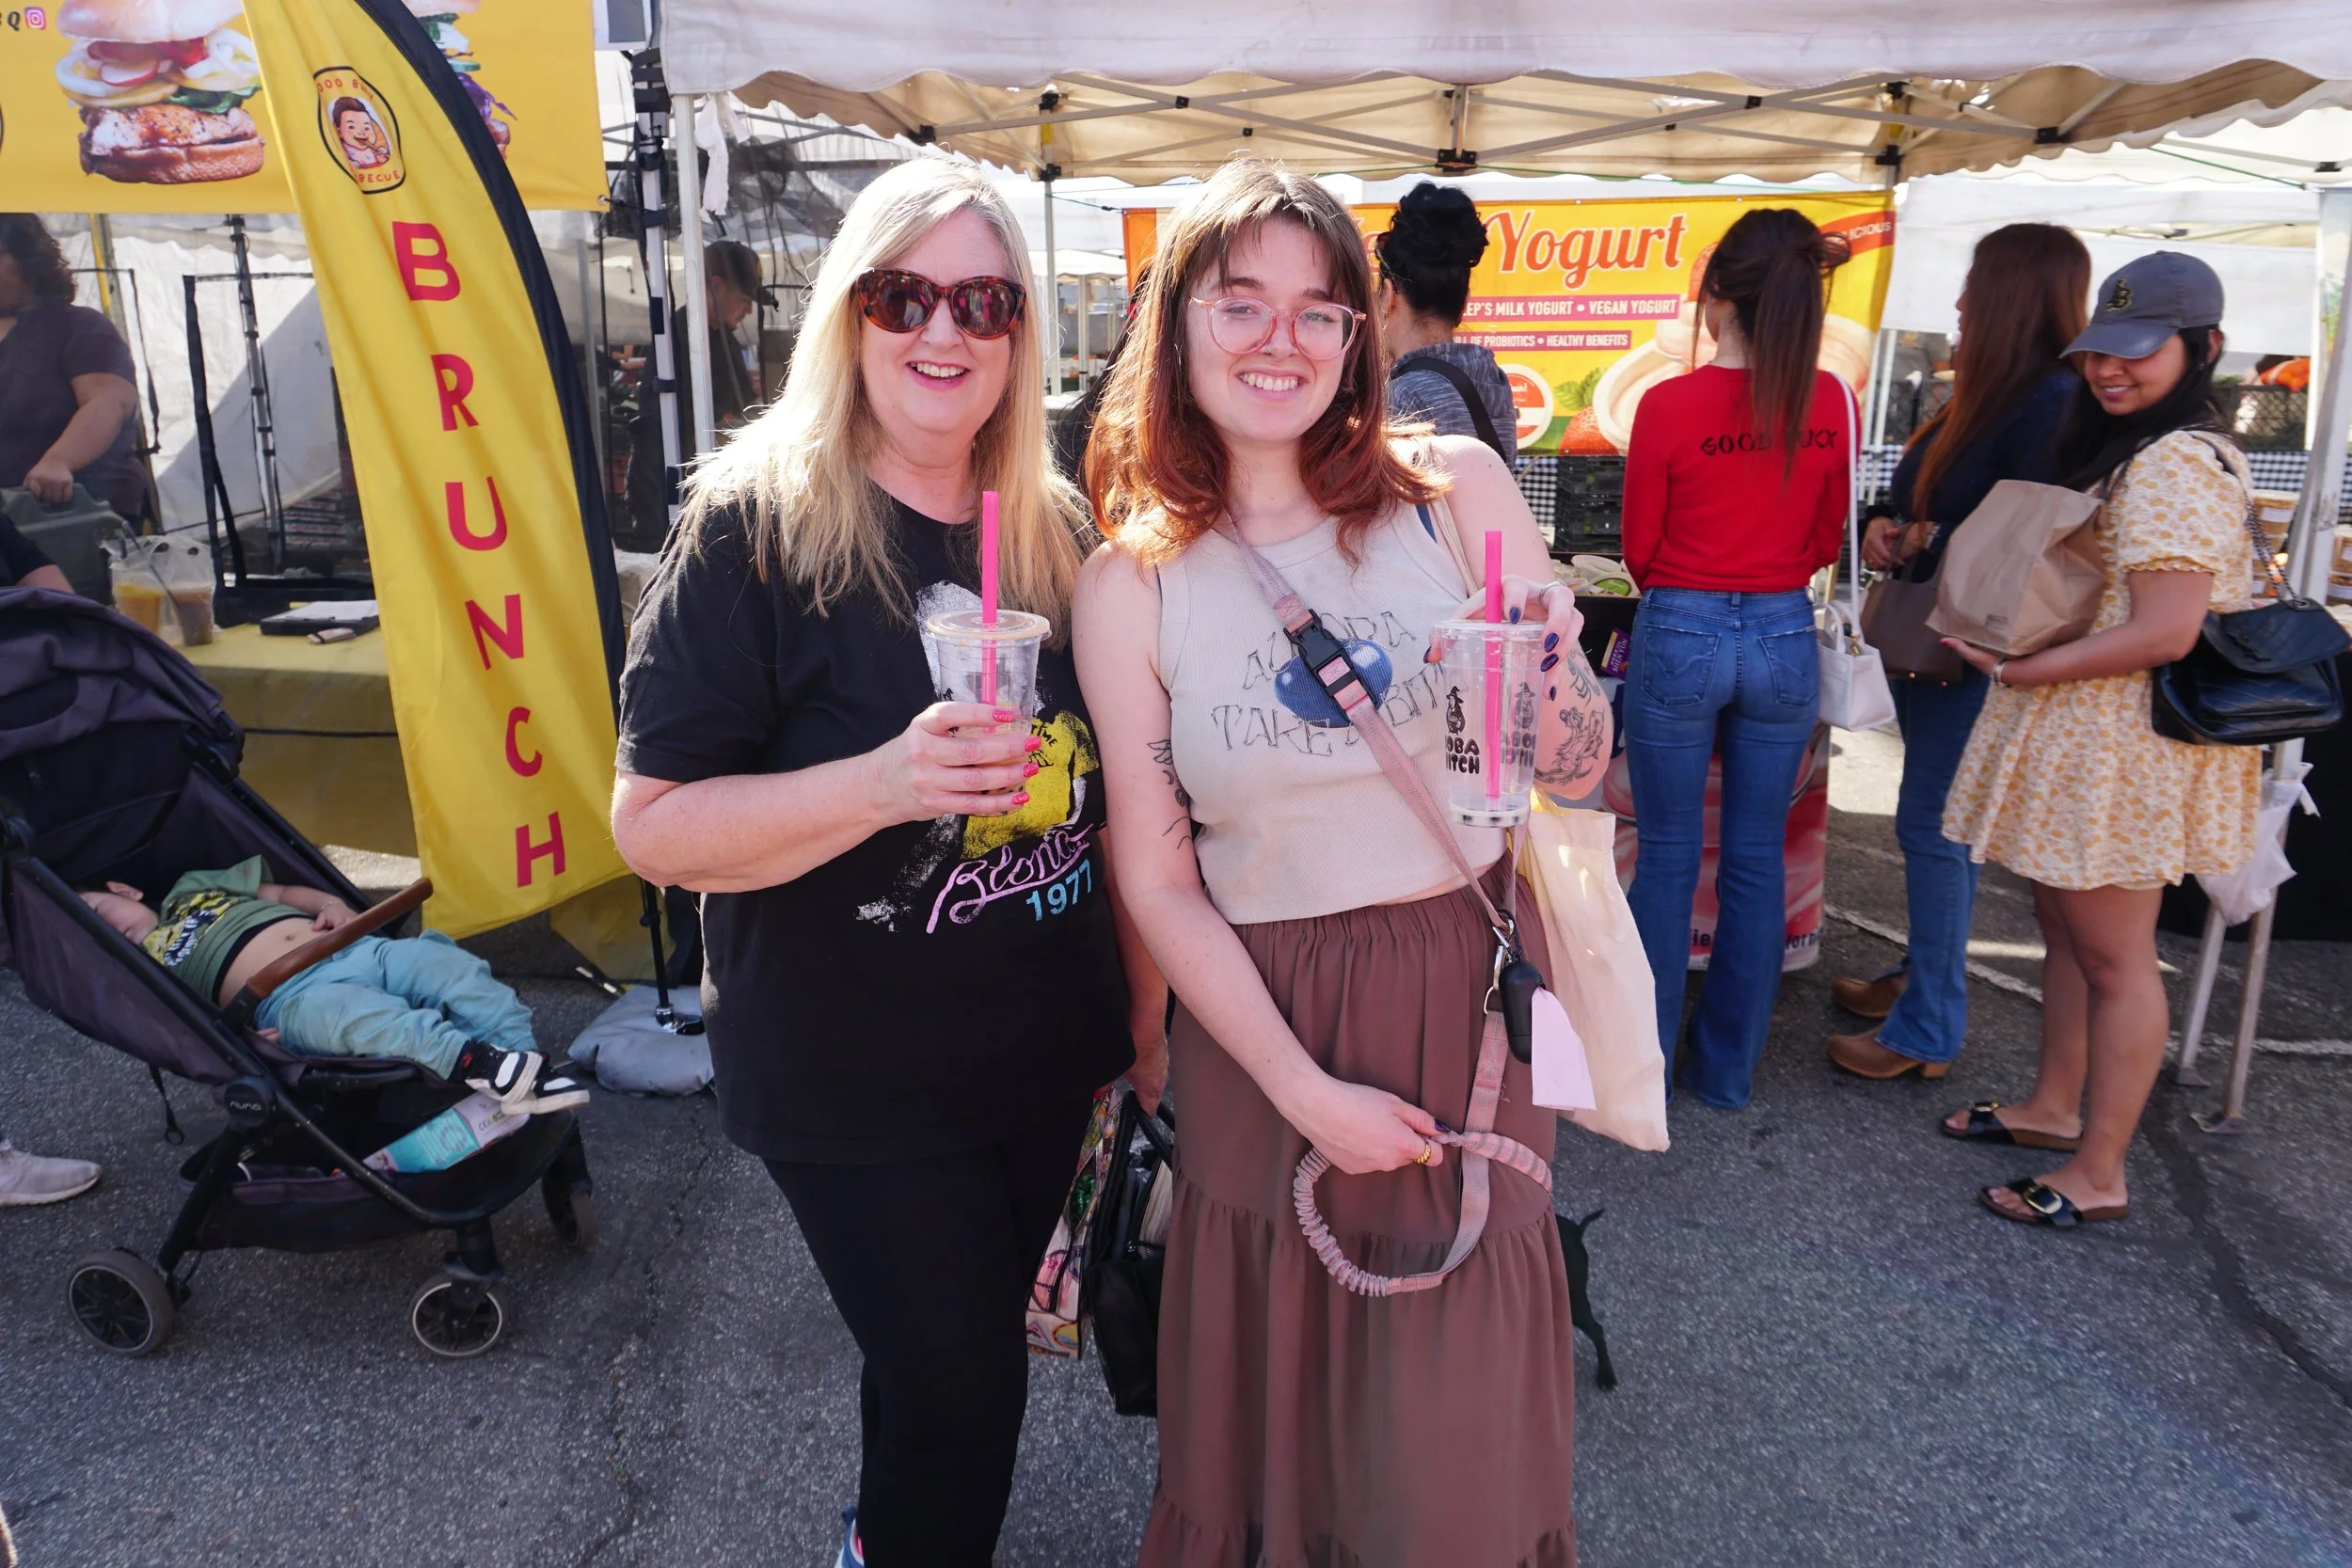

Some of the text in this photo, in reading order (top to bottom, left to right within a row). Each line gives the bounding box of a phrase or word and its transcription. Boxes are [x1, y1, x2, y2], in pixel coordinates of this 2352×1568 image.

[1485, 210, 1688, 290] Yogurt
[1495, 302, 1524, 316] MILK
[1528, 300, 1574, 315] YOGURT
[1588, 300, 1629, 314] VEGAN
[1630, 299, 1677, 314] YOGURT
[1484, 334, 1535, 347] PROBIOTICS
[1547, 334, 1584, 346] HEALTHY
[1585, 333, 1629, 346] BENEFITS
[392, 220, 565, 888] BRUNCH
[1211, 705, 1332, 756] TAKE
[1378, 662, 1445, 728] BIT
[1445, 736, 1480, 756] OBA
[1445, 753, 1480, 774] ITCH
[1025, 859, 1091, 922] 1977
